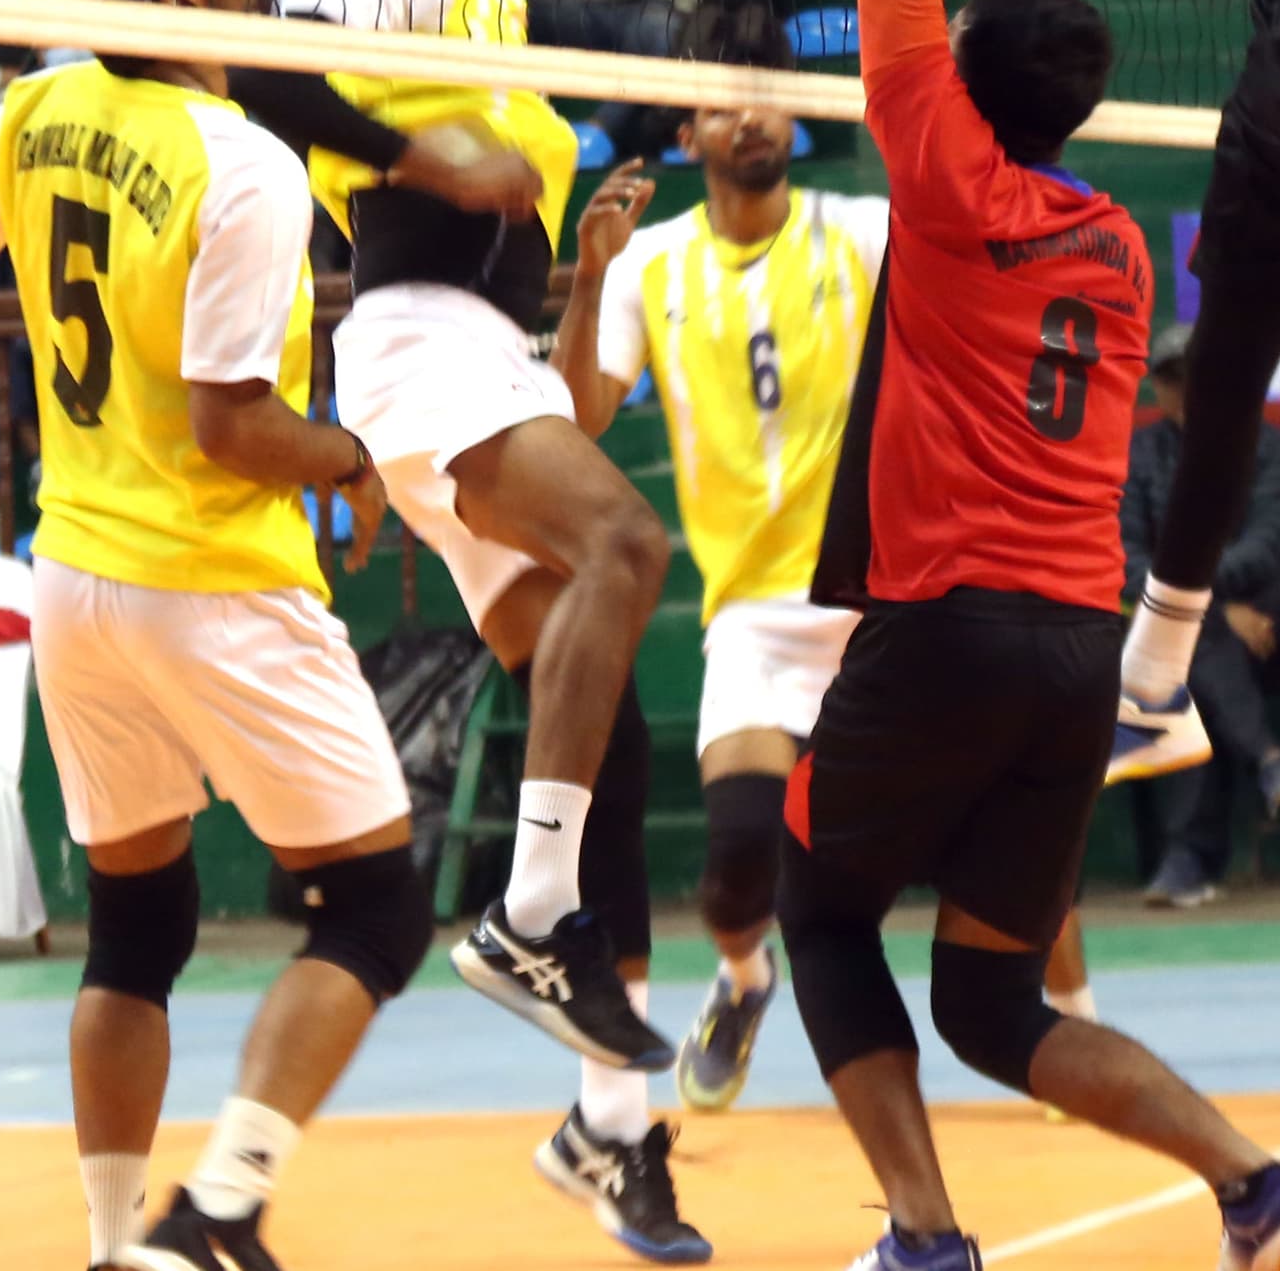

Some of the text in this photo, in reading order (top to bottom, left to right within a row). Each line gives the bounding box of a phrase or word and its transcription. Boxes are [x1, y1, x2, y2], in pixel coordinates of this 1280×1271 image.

[50, 193, 114, 428] 5
[748, 329, 782, 411] 6
[1026, 295, 1101, 443] 8
